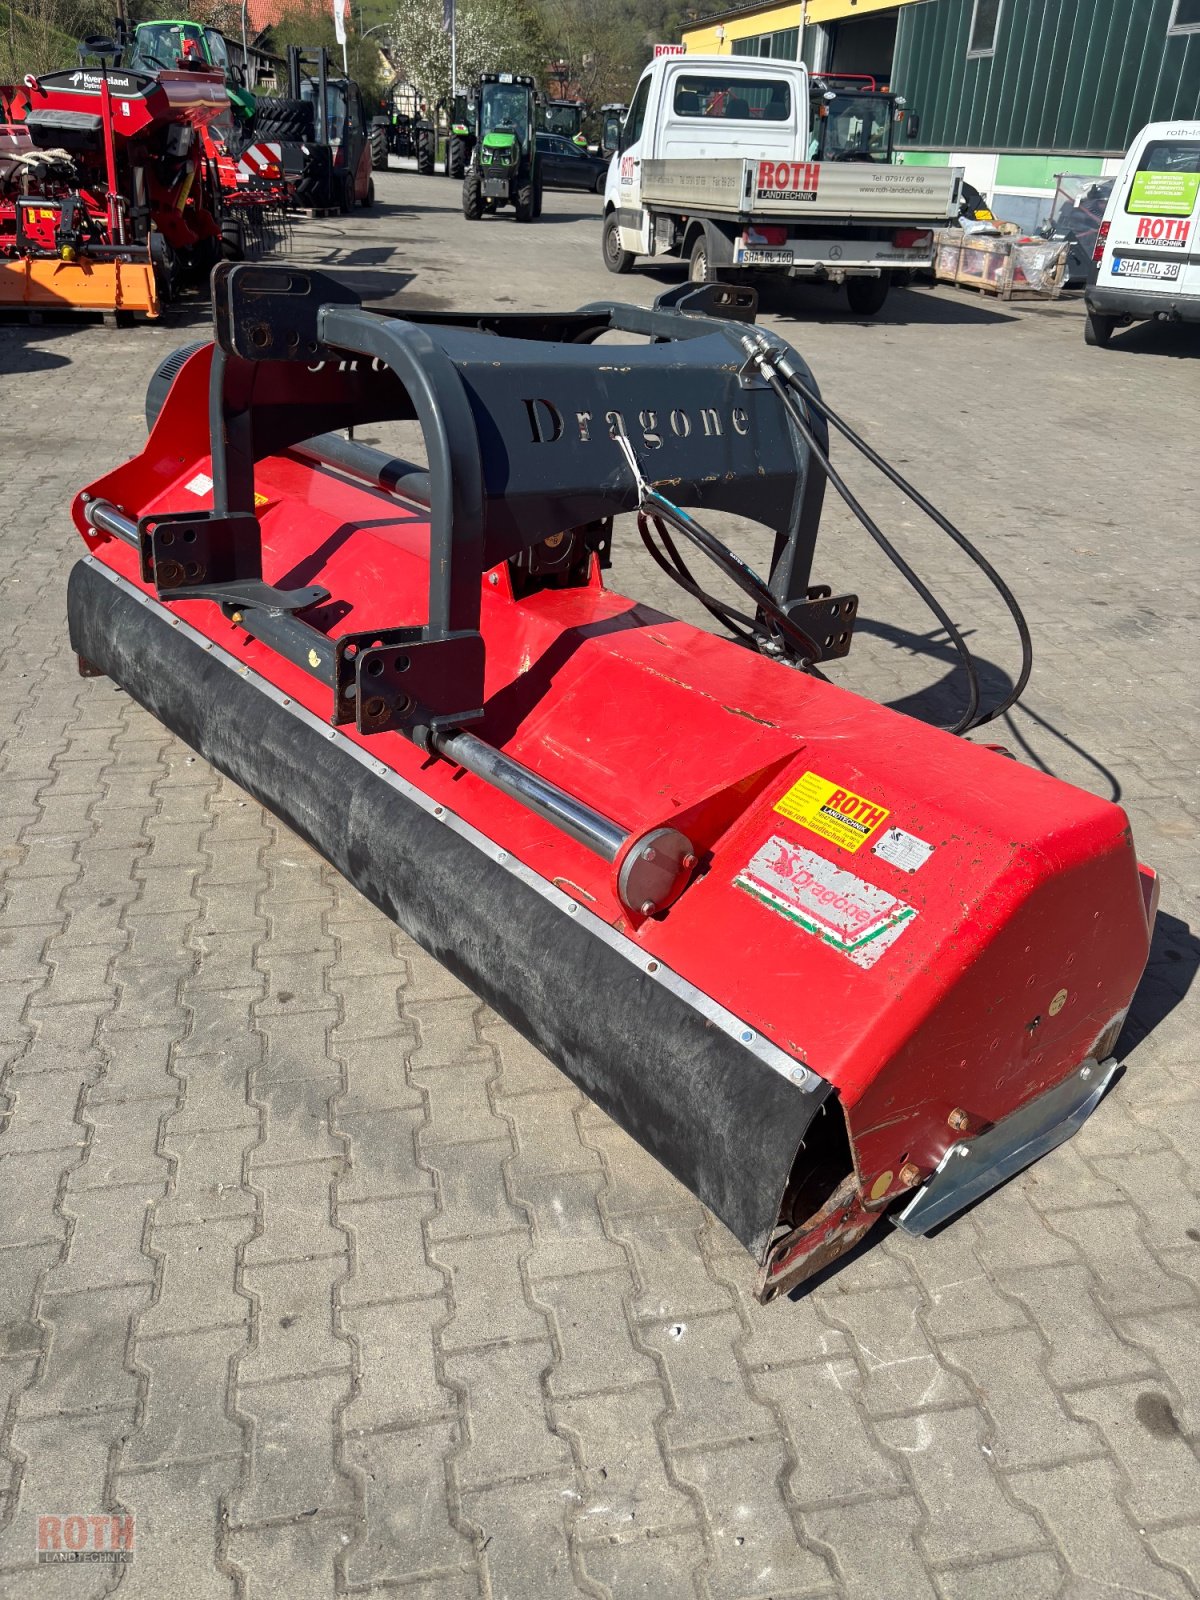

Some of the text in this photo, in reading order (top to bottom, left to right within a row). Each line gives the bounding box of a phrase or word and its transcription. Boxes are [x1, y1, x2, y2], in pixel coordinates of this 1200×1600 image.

[655, 46, 684, 57] ROTH
[757, 162, 821, 191] ROTH
[760, 191, 815, 201] LANDTECHNIK
[1136, 218, 1191, 241] ROTH
[1138, 238, 1183, 247] LANDTECHNIK
[744, 252, 759, 262] SHA
[765, 252, 775, 263] RL
[1120, 261, 1140, 272] SHA
[1147, 263, 1161, 275] RL
[1163, 264, 1178, 276] 38
[521, 398, 750, 450] Dragone
[822, 806, 868, 833] LANDTECHNIK
[824, 788, 887, 829] ROTH
[777, 805, 857, 850] www.roth-landtechnik.de
[789, 868, 872, 924] Dragone
